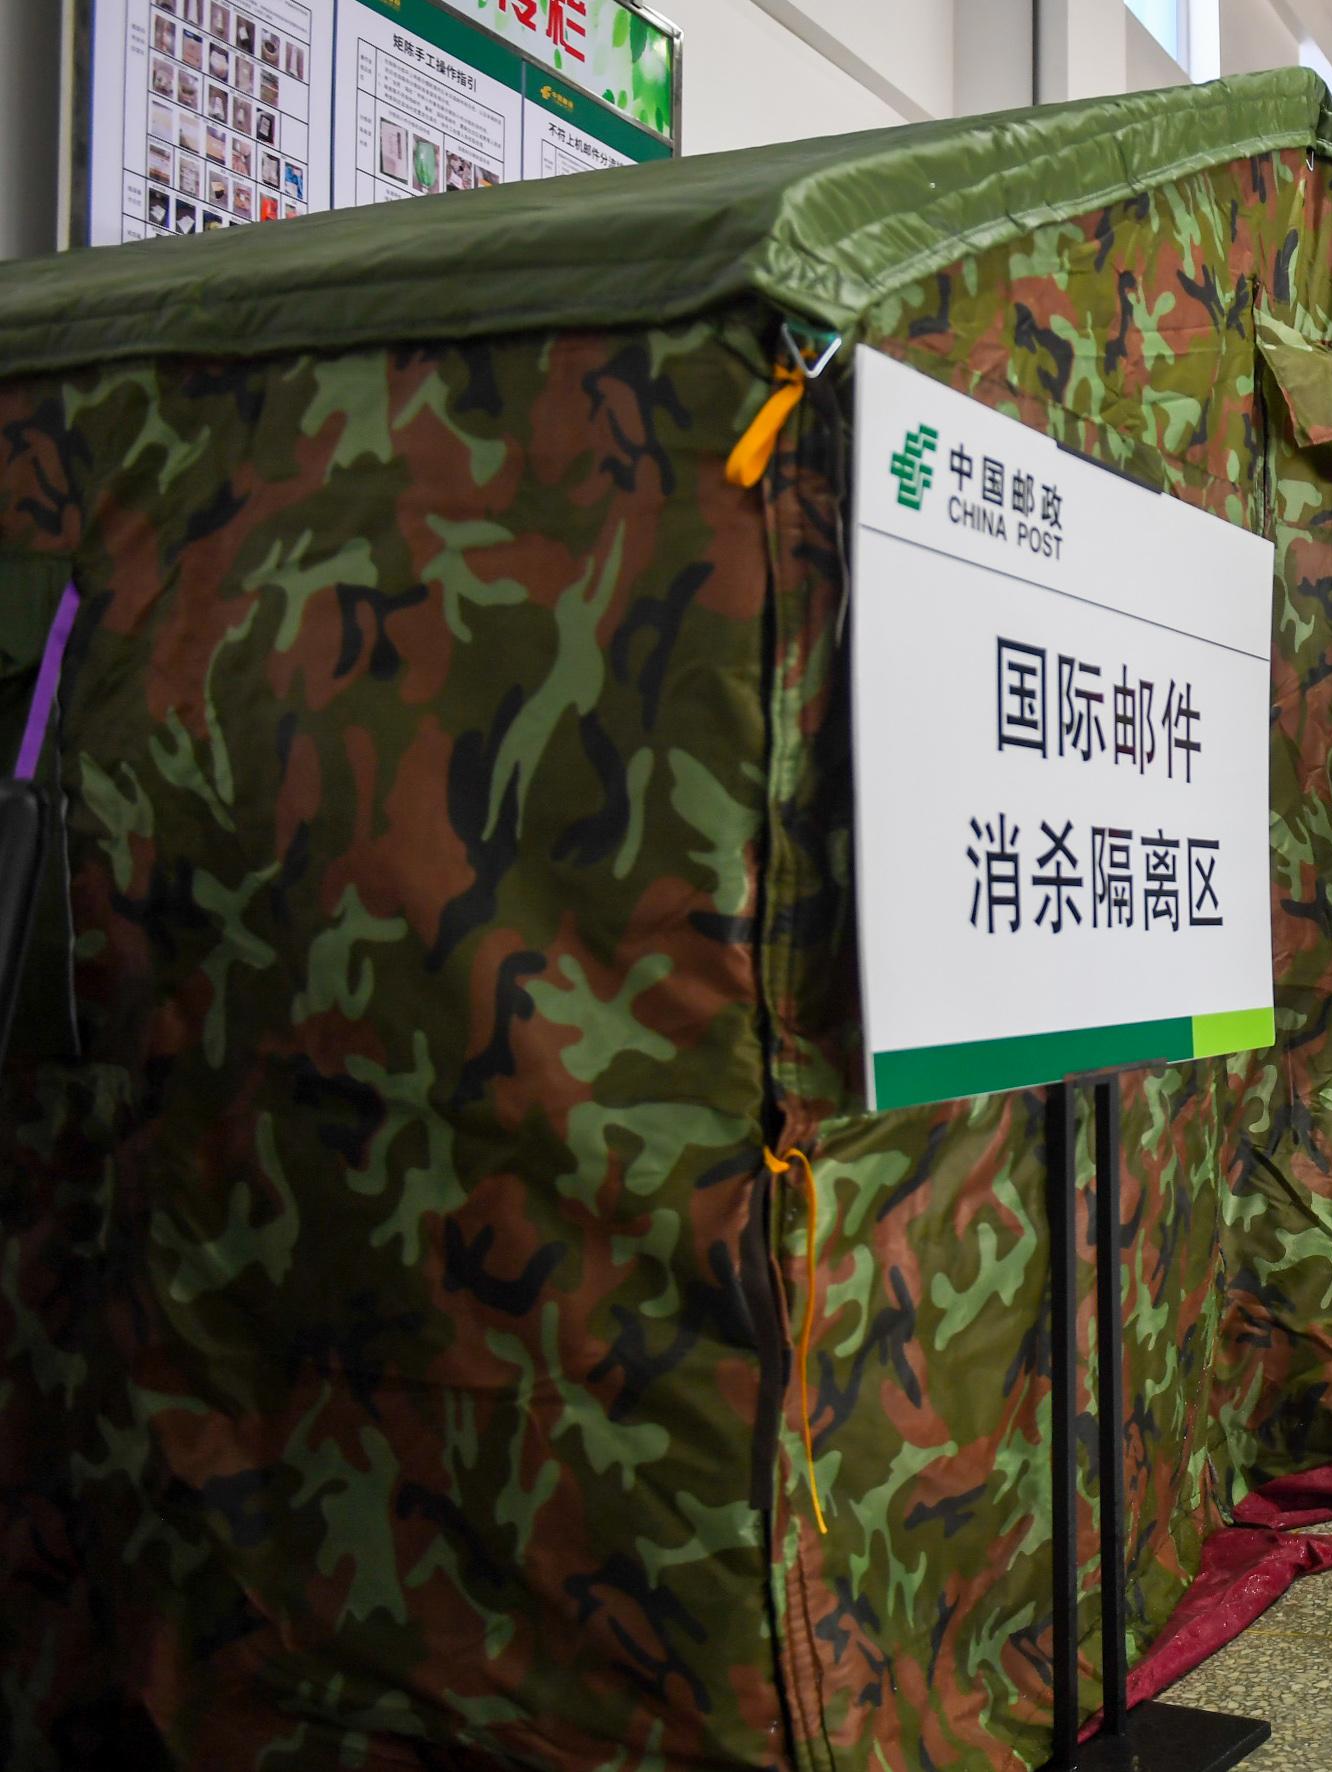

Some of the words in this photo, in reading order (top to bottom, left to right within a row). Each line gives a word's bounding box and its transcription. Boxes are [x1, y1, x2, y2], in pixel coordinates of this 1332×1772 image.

[948, 494, 1007, 542] CHINA
[1017, 521, 1063, 561] POST
[949, 442, 1063, 530] 中国邮政
[996, 635, 1202, 784] 国际邮件
[965, 812, 1224, 934] 消杀隔离区
